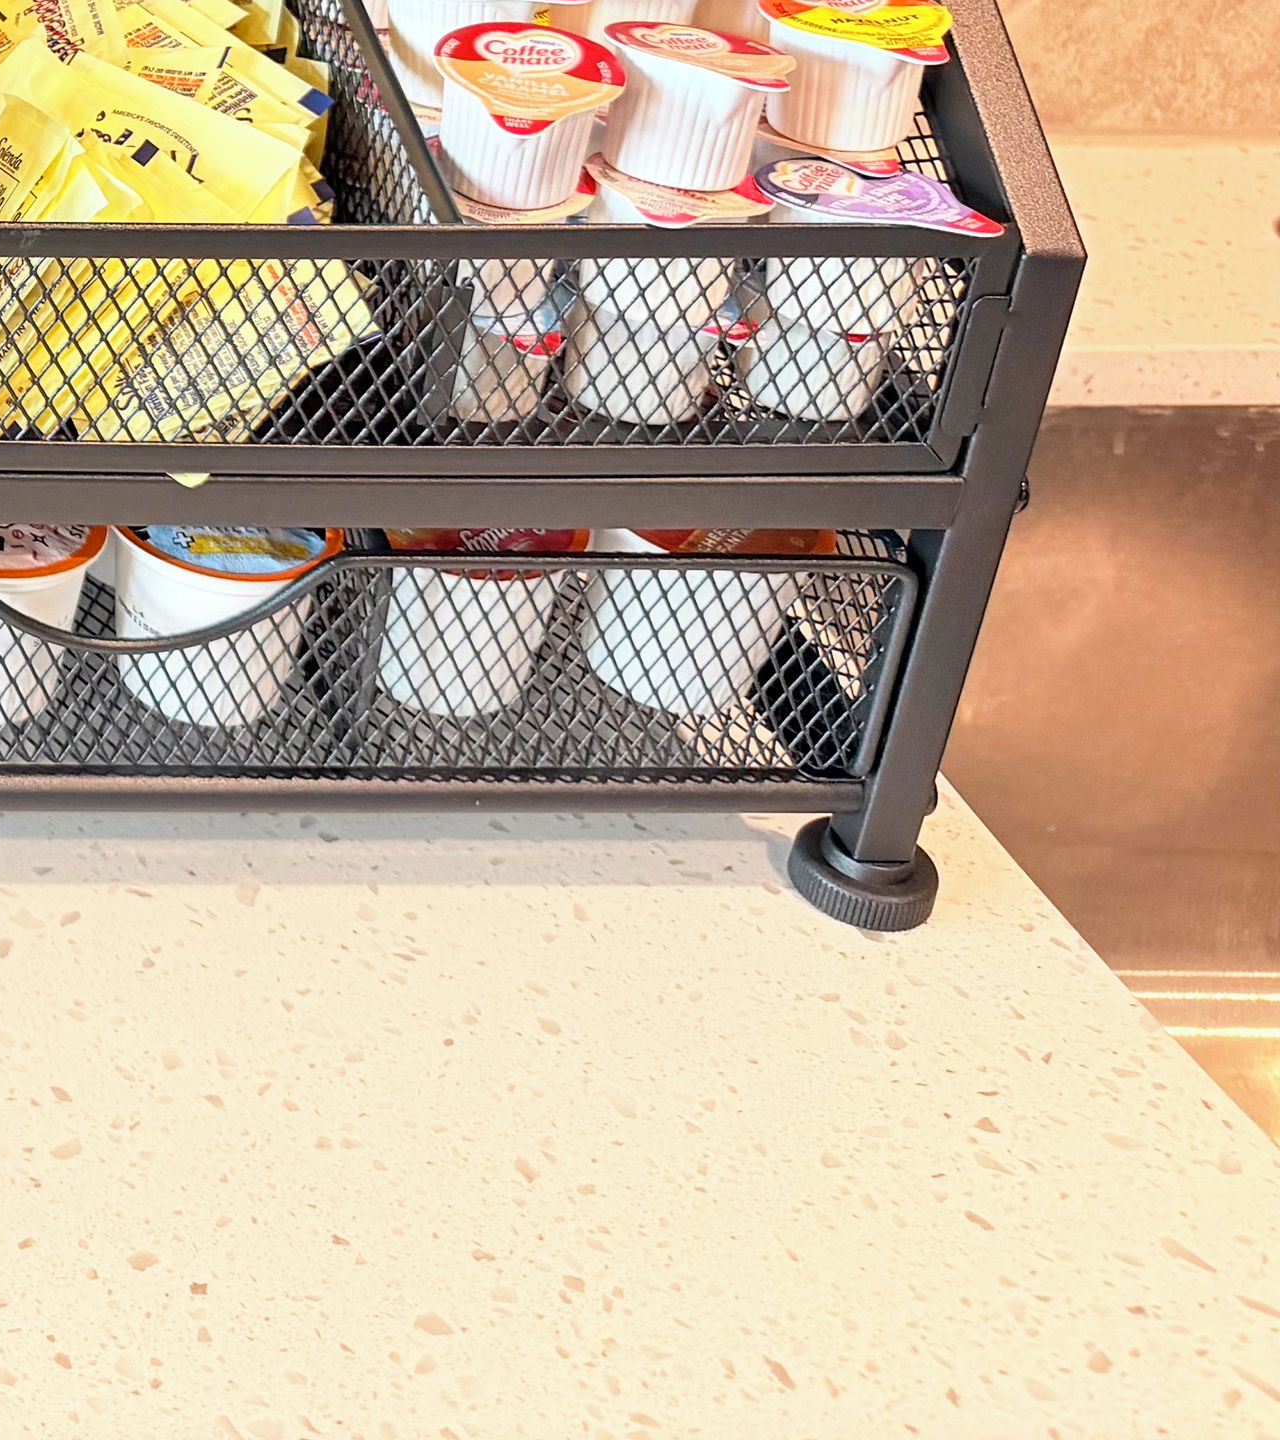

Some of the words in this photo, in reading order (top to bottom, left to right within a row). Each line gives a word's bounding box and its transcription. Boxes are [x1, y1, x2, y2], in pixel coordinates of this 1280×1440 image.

[483, 39, 566, 57] Coffee
[640, 33, 708, 47] Coffee
[502, 55, 568, 66] mate
[477, 78, 570, 97] CARAMEL
[480, 71, 566, 90] VANILLA
[111, 108, 145, 122] AMERICA'S
[782, 164, 830, 192] Coffee
[814, 168, 845, 194] mate
